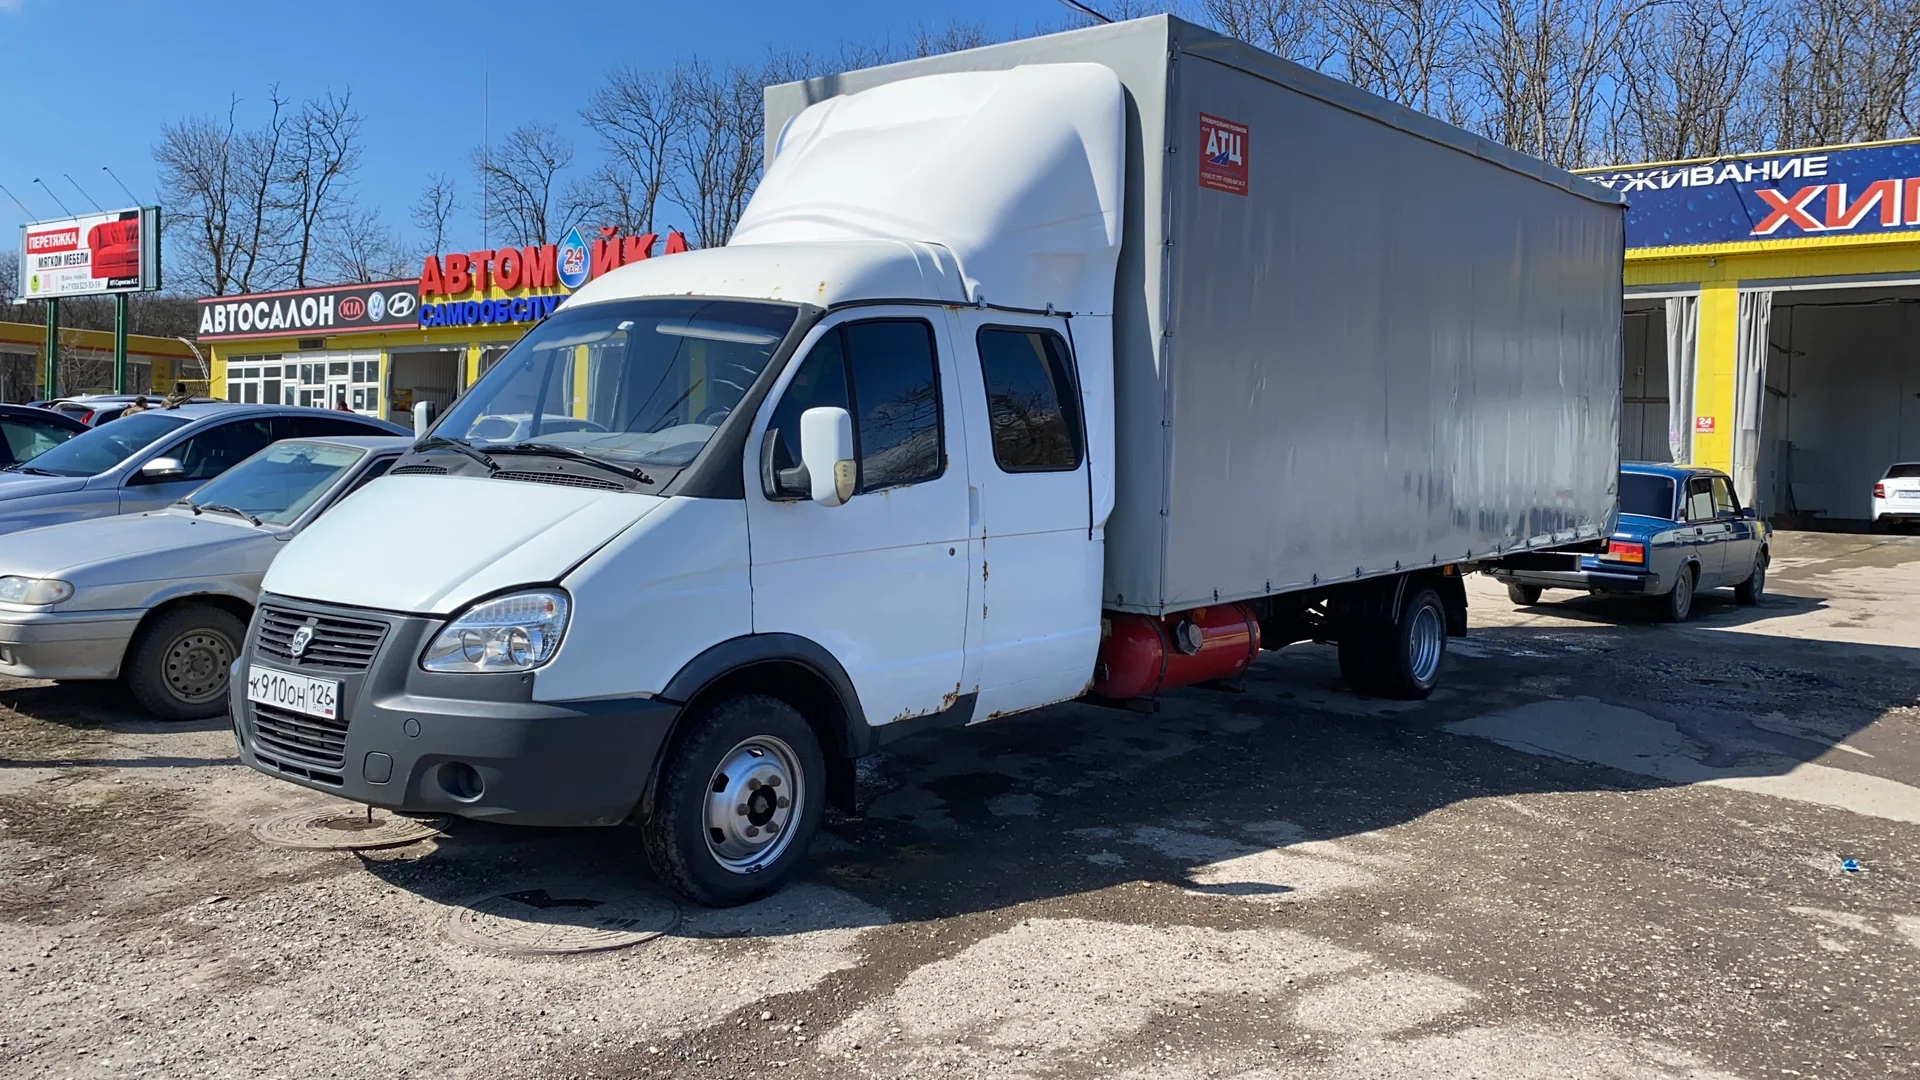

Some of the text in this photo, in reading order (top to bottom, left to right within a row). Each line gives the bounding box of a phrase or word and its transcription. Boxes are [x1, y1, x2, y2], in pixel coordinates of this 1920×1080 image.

[1205, 128, 1242, 165] АТЦ
[1585, 156, 1828, 193] УЖИВАНИЕ
[1750, 176, 1920, 236] ХИ
[29, 231, 77, 250] ПЕРЕТЯЖКА
[38, 252, 89, 268] МЯГКОЙ МЕБЕЛИ
[565, 246, 584, 265] 24
[564, 264, 583, 275] ЧАСА
[199, 295, 334, 334] АВТОСАЛОН
[342, 302, 361, 315] KIA
[419, 294, 568, 327] САМООБСЛУ
[1698, 417, 1712, 425] 24
[309, 683, 332, 706] 126
